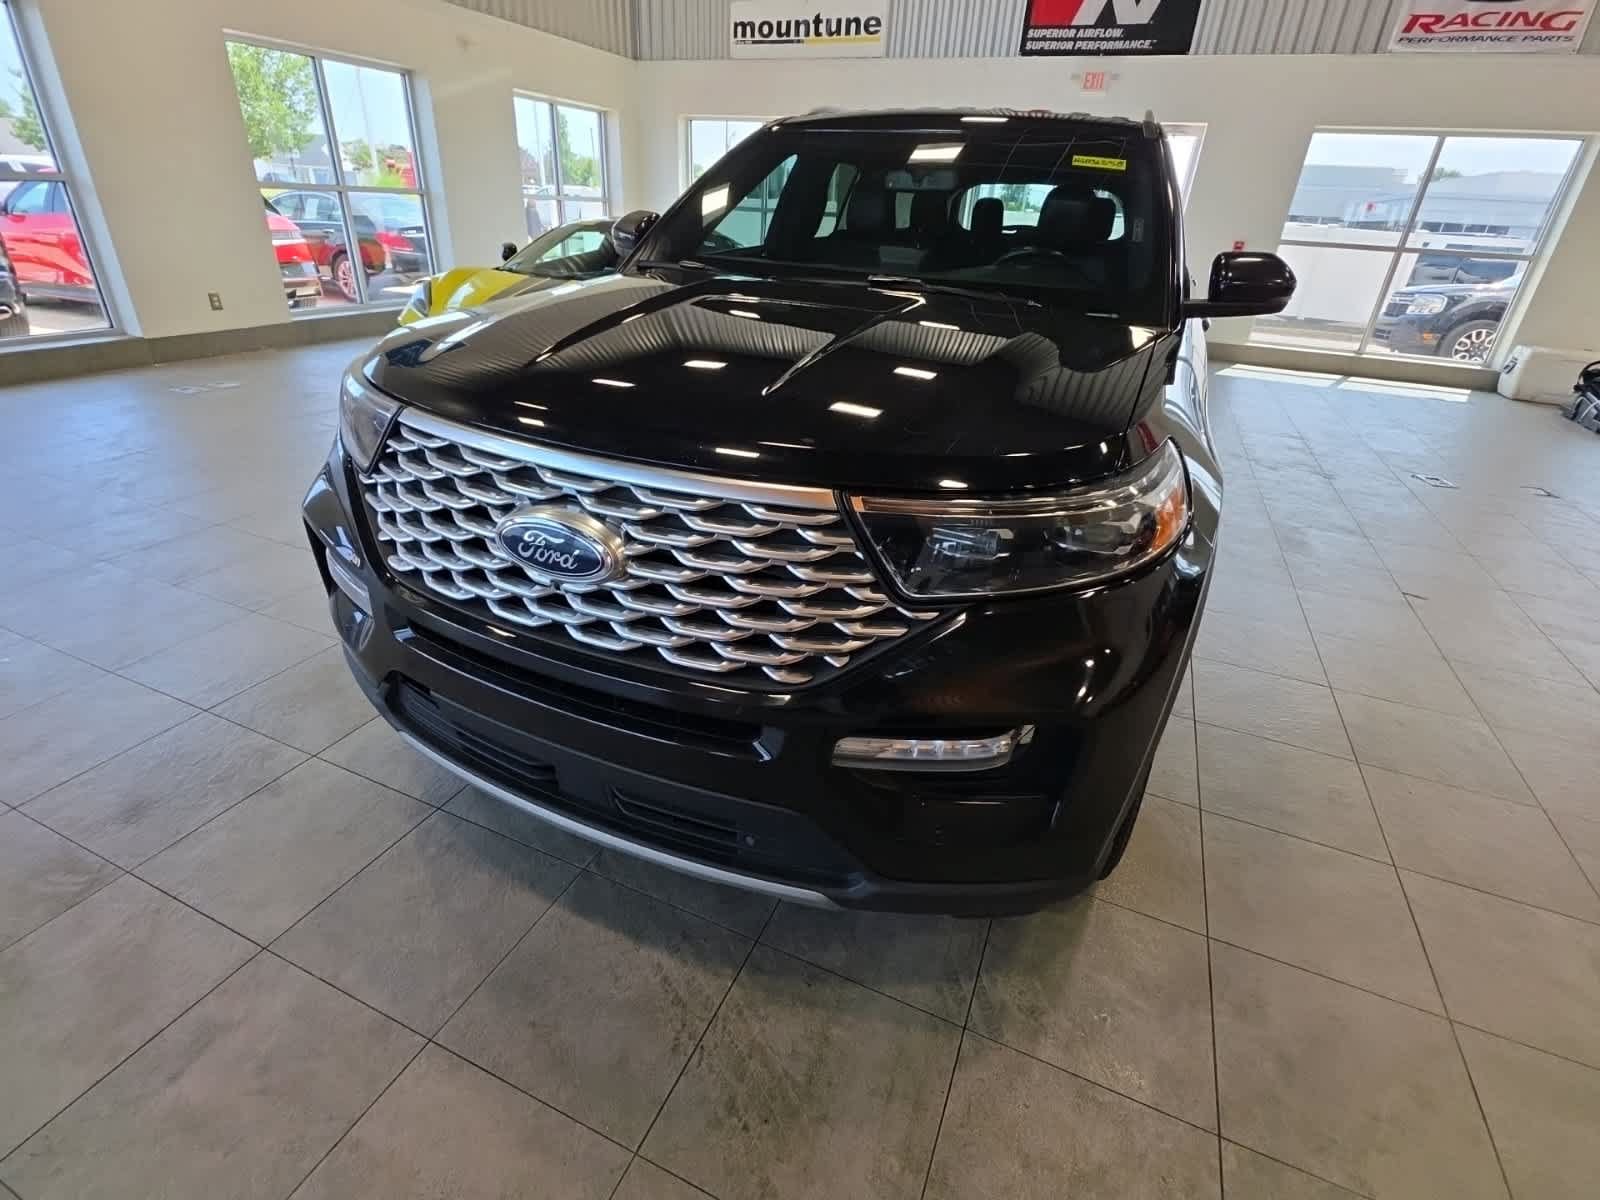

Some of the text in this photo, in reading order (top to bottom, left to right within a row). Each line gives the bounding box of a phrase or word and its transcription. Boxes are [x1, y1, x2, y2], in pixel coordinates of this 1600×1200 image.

[733, 13, 882, 38] mountune
[1402, 11, 1584, 33] RACING
[1027, 28, 1124, 38] SUPERIOR AIRFLOW.
[1398, 34, 1576, 43] PERFORMANCE PARTS
[1025, 40, 1074, 50] SUPERIOR
[1083, 72, 1104, 89] EXIT
[518, 529, 580, 570] Ford
